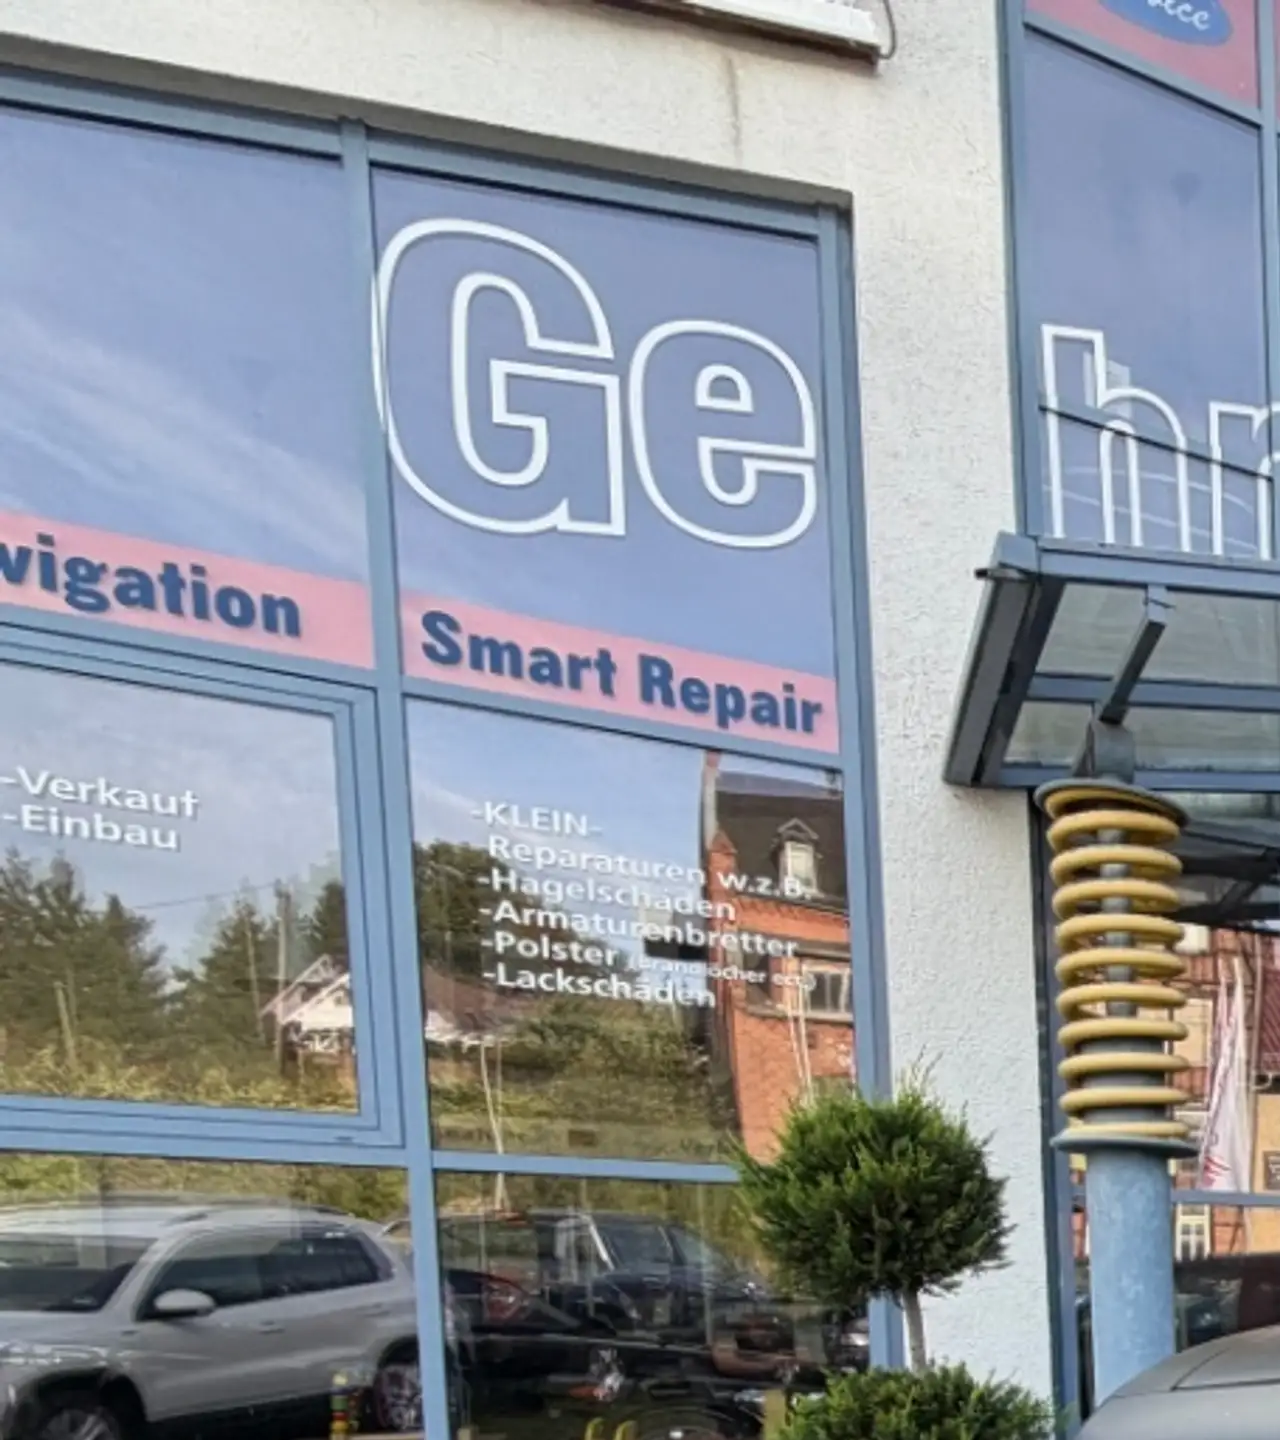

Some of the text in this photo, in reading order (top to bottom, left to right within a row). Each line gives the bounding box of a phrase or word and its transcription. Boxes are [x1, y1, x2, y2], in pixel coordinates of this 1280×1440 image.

[371, 217, 818, 550] Ge
[421, 610, 823, 734] Smart Repair
[3, 804, 178, 850] -Einbau
[471, 801, 603, 836] -KLEIN-
[488, 835, 706, 885] Reparaturen
[478, 900, 799, 957] -Armaturenbretter
[480, 931, 620, 966] -Polster
